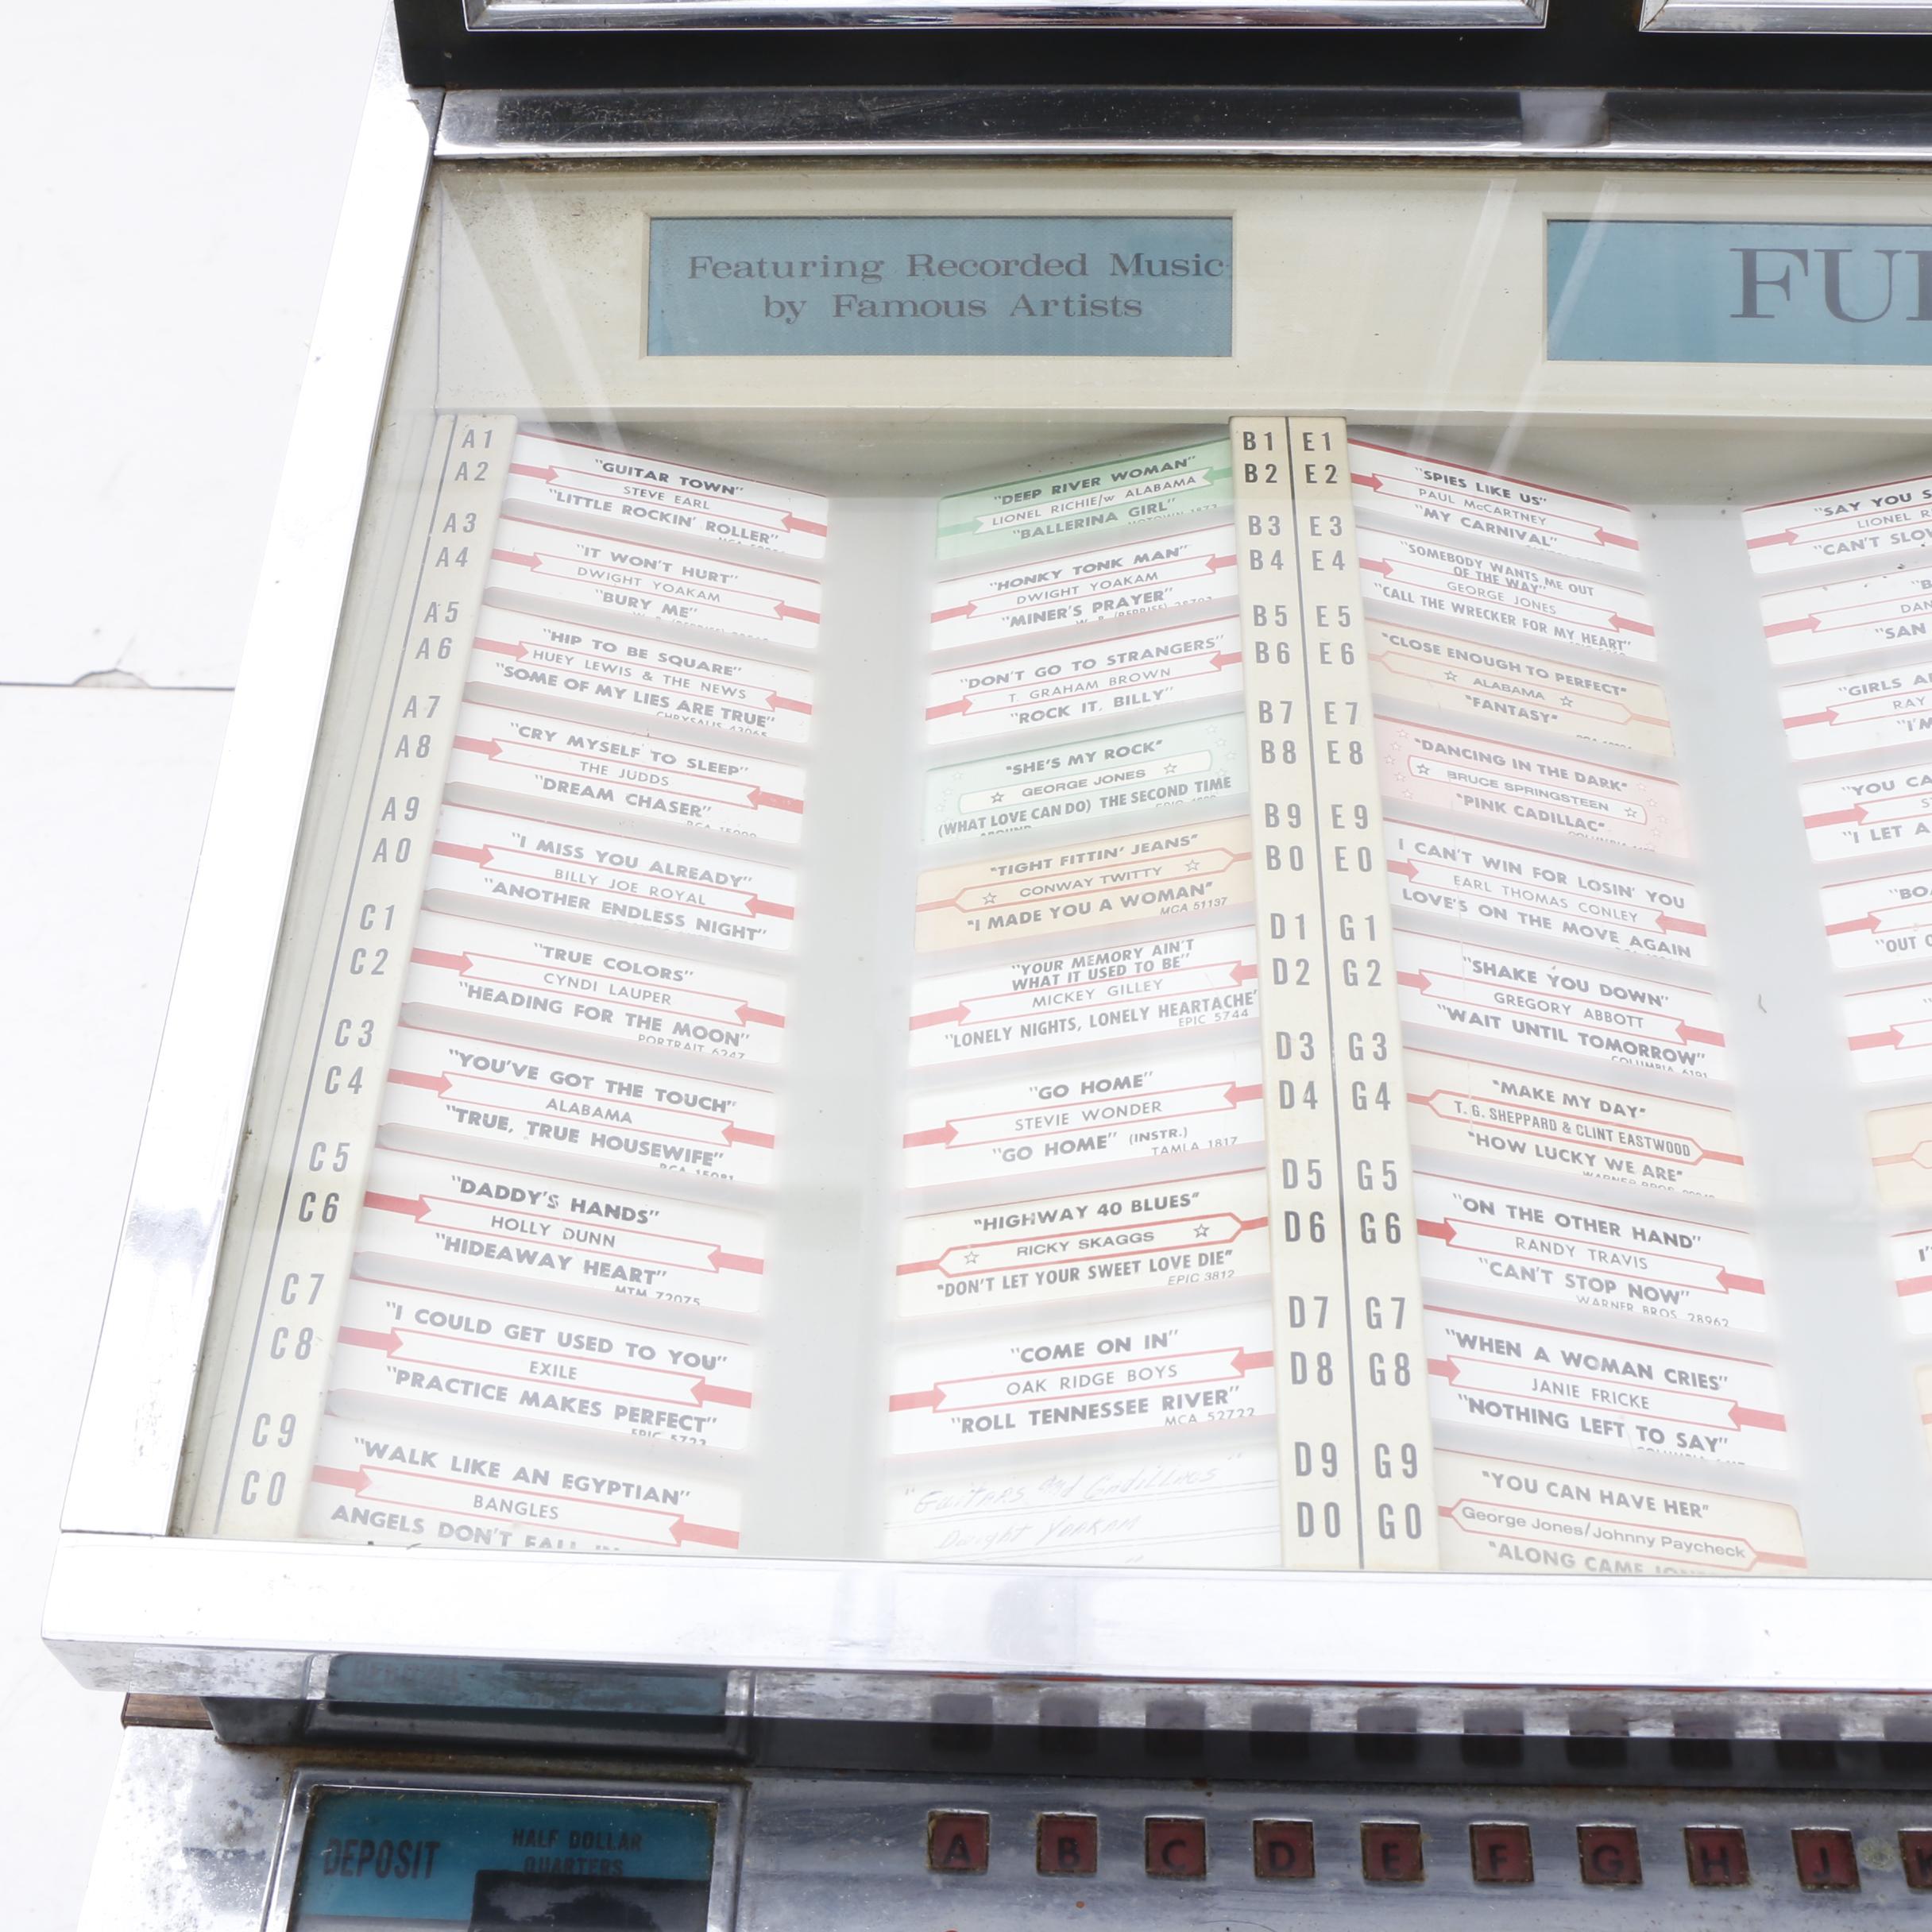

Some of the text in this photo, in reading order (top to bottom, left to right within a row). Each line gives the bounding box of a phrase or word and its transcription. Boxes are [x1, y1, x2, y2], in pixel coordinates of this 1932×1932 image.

[687, 252, 1224, 284] Featuring Recorded Music
[763, 293, 1142, 323] by Famous Artists
[596, 459, 743, 495] "GUITAR TOWN"
[995, 457, 1199, 504] "DEEP RIVER WOMAN"
[624, 486, 709, 509] STEVE EARL
[993, 509, 1041, 525] LIONEL
[1125, 477, 1196, 498] ALABAMA
[1419, 489, 1546, 525] PAUL McCARTNEY
[1857, 513, 1911, 528] LIONEL
[578, 567, 720, 602] DWIGHT YOAKAM
[1017, 572, 1161, 604] DWIGHT YOAKAM
[533, 650, 746, 699] HUEY LEWIS & THE NEWS
[1030, 680, 1099, 699] GRAHAM
[1108, 668, 1175, 690] BROWN
[1473, 678, 1544, 700] ALABAMA
[496, 663, 775, 728] "SOME OF MY LIES ARE TRUE"
[1893, 697, 1925, 709] RAY
[580, 761, 668, 786] THE JUDDS
[1415, 738, 1627, 791] "DANCING IN THE DARK"
[1022, 770, 1146, 797] GEORGE JONES
[1447, 771, 1609, 811] BRUCE SPRINGSTEEN
[938, 776, 1231, 837] (WHAT LOVE CAN DO) THE SECOND TIME
[1843, 822, 1930, 844] "I LET A
[552, 869, 705, 906] BILLY JOE ROYAL
[1020, 867, 1161, 897] CONWAY TWITTY
[1399, 838, 1684, 909] I CAN'T WIN FOR LOSIN' YOU
[1161, 897, 1227, 915] MCA 51137
[1454, 875, 1637, 922] EARL THOMAS CONLEY
[544, 973, 670, 1005] CYNDI LAUPER
[1033, 979, 1163, 1007] MICKEY GILLEY
[460, 983, 749, 1046] "HEADING FOR THE MOON"
[1179, 1009, 1248, 1026] EPIC 5744
[1494, 992, 1644, 1028] GREGORY ABBOTT
[546, 1099, 632, 1123] ALABAMA
[1493, 1080, 1645, 1118] "MAKE MY DAY"
[1015, 1101, 1161, 1130] STEVIE WONDER
[1490, 1107, 1557, 1131] SHEPPARD
[1563, 1122, 1571, 1134] &
[1576, 1124, 1613, 1142] CLINT
[1619, 1132, 1690, 1157] EASTWOOD
[974, 1192, 1199, 1231] "HIGHWAY 40 BLUES"
[1453, 1194, 1700, 1248] "ON THE OTHER HAND"
[492, 1215, 615, 1247] HOLLY DUNN
[1017, 1232, 1154, 1256] RICKY SKAGGS
[1516, 1237, 1648, 1269] RANDY TRAVIS
[1168, 1269, 1235, 1285] EPIC 3812
[530, 1361, 577, 1380] EXILE
[1007, 1365, 1177, 1395] OAK RIDGE BOYS
[1532, 1378, 1649, 1409] JANIE FRICKE
[355, 1438, 690, 1505] "WALK LIKE AN EGYPTIAN"
[473, 1495, 558, 1520] BANGLES
[1462, 1506, 1526, 1528] George
[1661, 1531, 1745, 1558] Paycheck
[512, 1830, 643, 1852] HALF DOLLAR
[944, 1833, 971, 1865] A
[1057, 1837, 1080, 1868] B
[1161, 1840, 1186, 1871] C
[1269, 1841, 1296, 1872] D
[323, 1837, 441, 1880] DEPOSIT
[523, 1857, 624, 1876] QUARTERS
[1381, 1844, 1400, 1875] E
[1489, 1845, 1507, 1875] F
[1592, 1844, 1624, 1877] G
[1701, 1846, 1729, 1877] H
[1814, 1847, 1828, 1880] J
